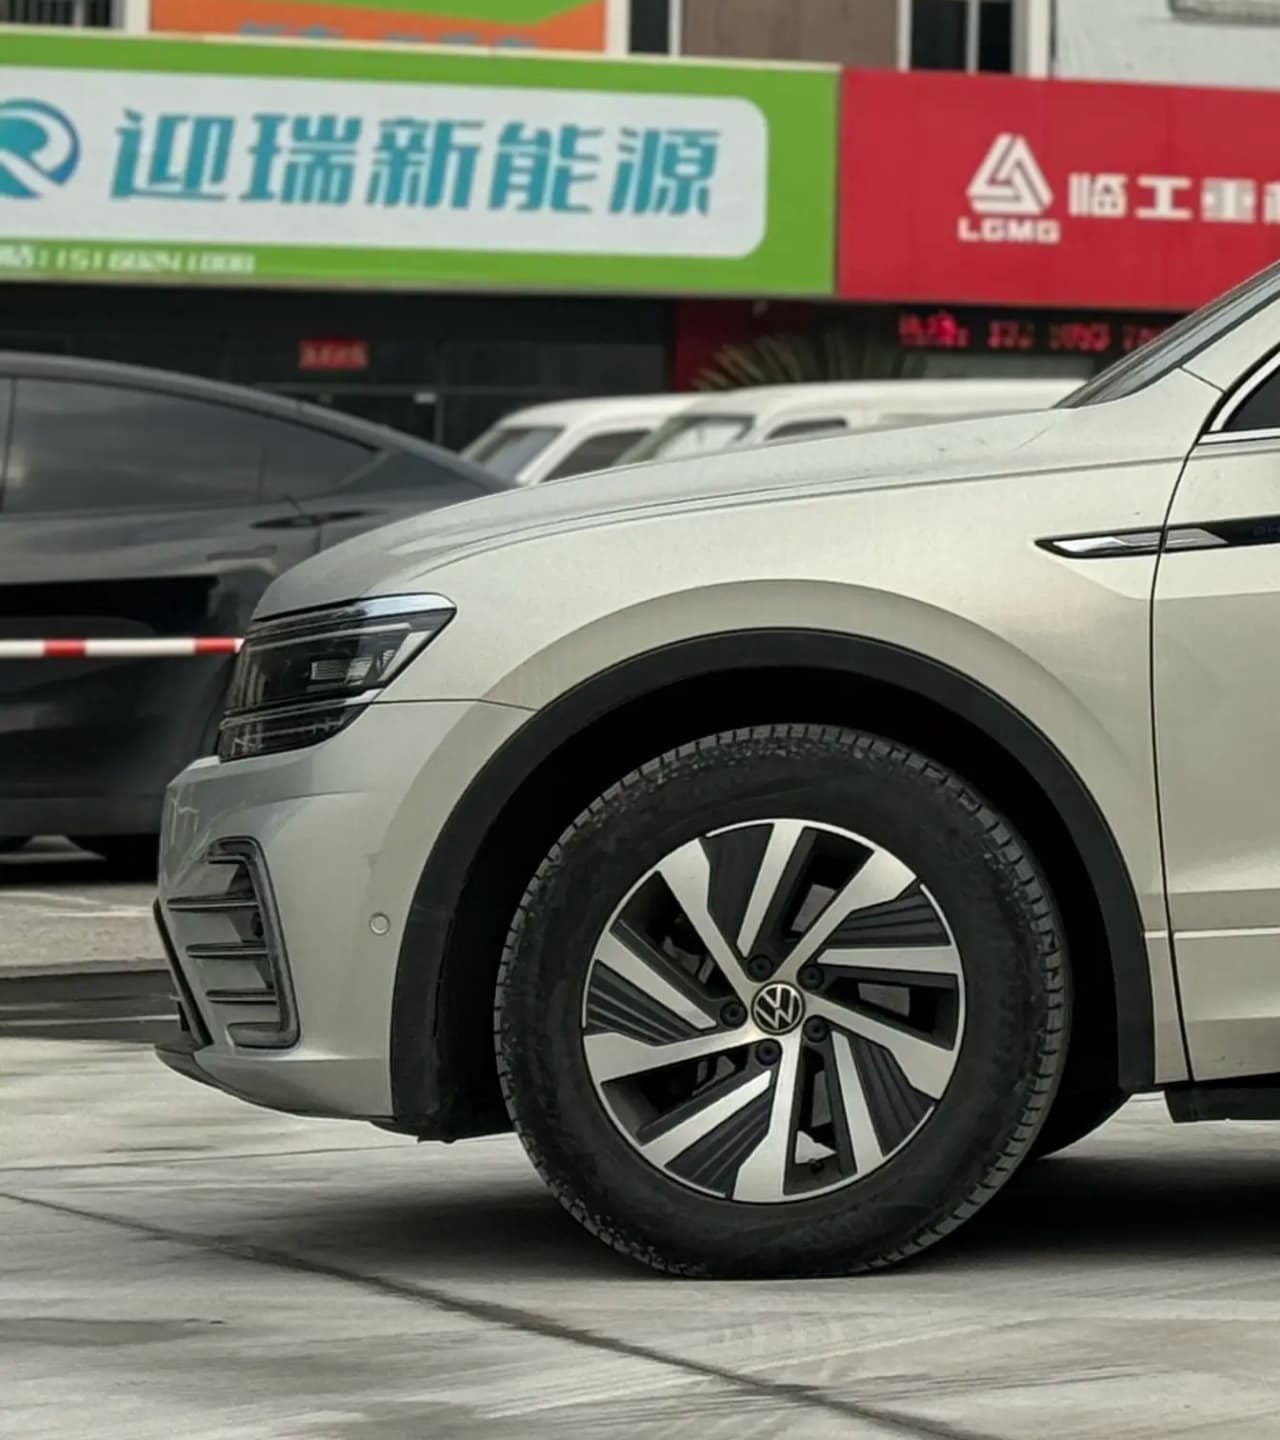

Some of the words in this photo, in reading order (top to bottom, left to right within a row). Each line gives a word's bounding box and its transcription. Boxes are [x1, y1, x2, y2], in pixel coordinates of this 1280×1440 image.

[110, 108, 722, 217] 迎瑞新能源
[957, 215, 1061, 245] LGMG
